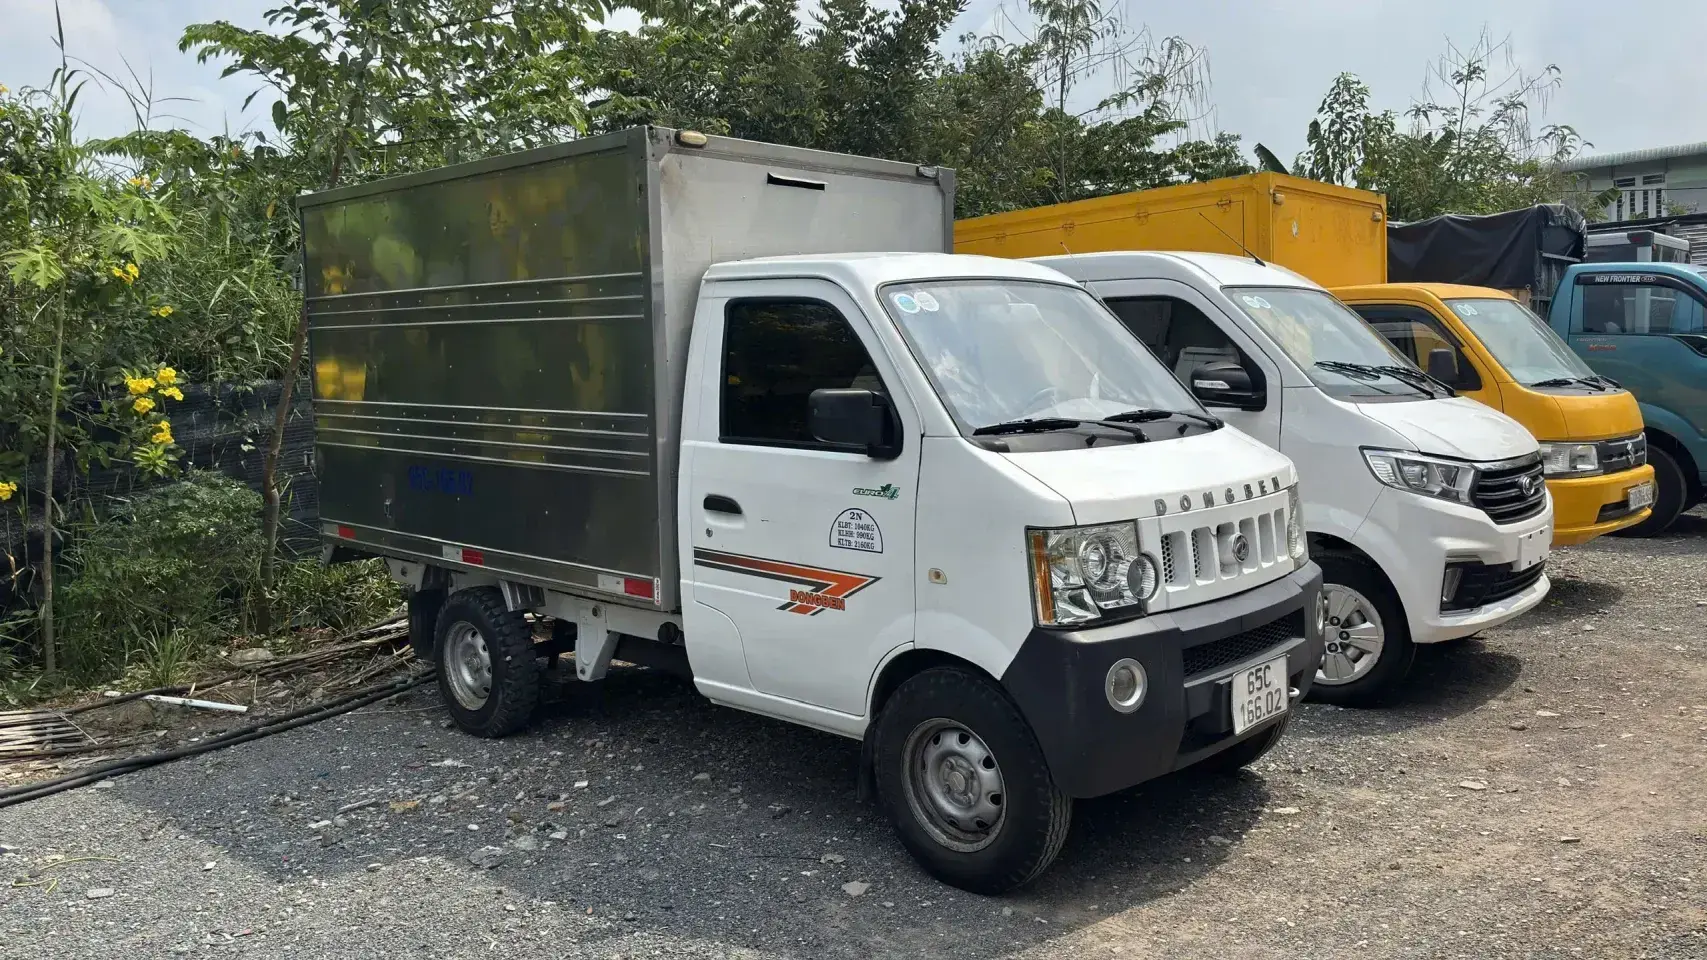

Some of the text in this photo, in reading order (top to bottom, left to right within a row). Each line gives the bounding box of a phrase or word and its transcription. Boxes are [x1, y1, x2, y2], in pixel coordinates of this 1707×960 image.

[1595, 275, 1609, 283] NEW
[1609, 275, 1641, 283] FRONTIER
[1154, 476, 1281, 516] DONGBEN
[849, 511, 863, 521] 2N
[838, 521, 853, 529] KLBT:
[856, 531, 875, 541] 990KG
[838, 538, 875, 549] KLTB: 2160KG
[790, 589, 845, 610] DONGBEN
[1247, 664, 1271, 695] 65C
[1240, 687, 1282, 727] 166.02
